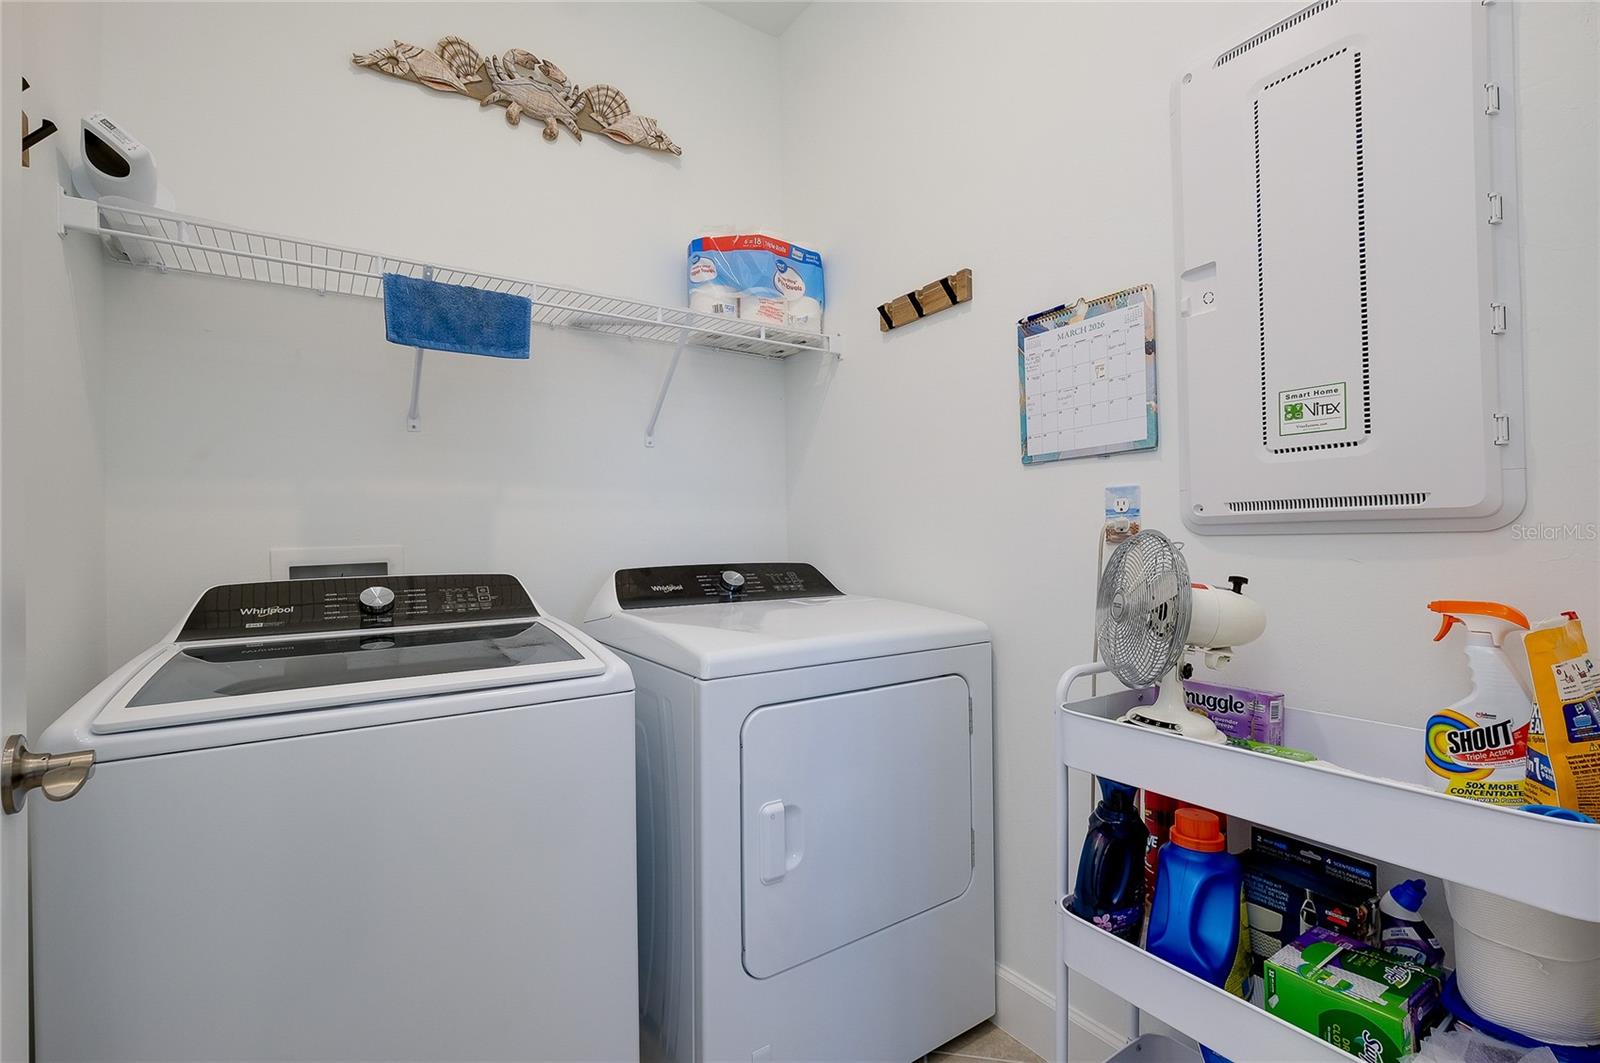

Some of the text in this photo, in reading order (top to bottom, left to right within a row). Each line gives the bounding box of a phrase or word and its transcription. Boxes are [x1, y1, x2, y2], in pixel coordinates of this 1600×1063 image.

[1057, 326, 1087, 341] MARCH
[1089, 320, 1105, 332] 2026
[1285, 387, 1339, 401] Smart Home
[650, 583, 684, 593] Whirlpool
[239, 605, 295, 618] Whirlpool
[1185, 690, 1245, 714] nuggle
[1447, 720, 1512, 754] SHOUT
[1465, 753, 1488, 762] Triple
[1489, 748, 1514, 758] Acting
[1450, 787, 1525, 797] CONCENTRATE
[1465, 782, 1519, 791] 50X MORE
[1332, 1023, 1341, 1048] CLOT
